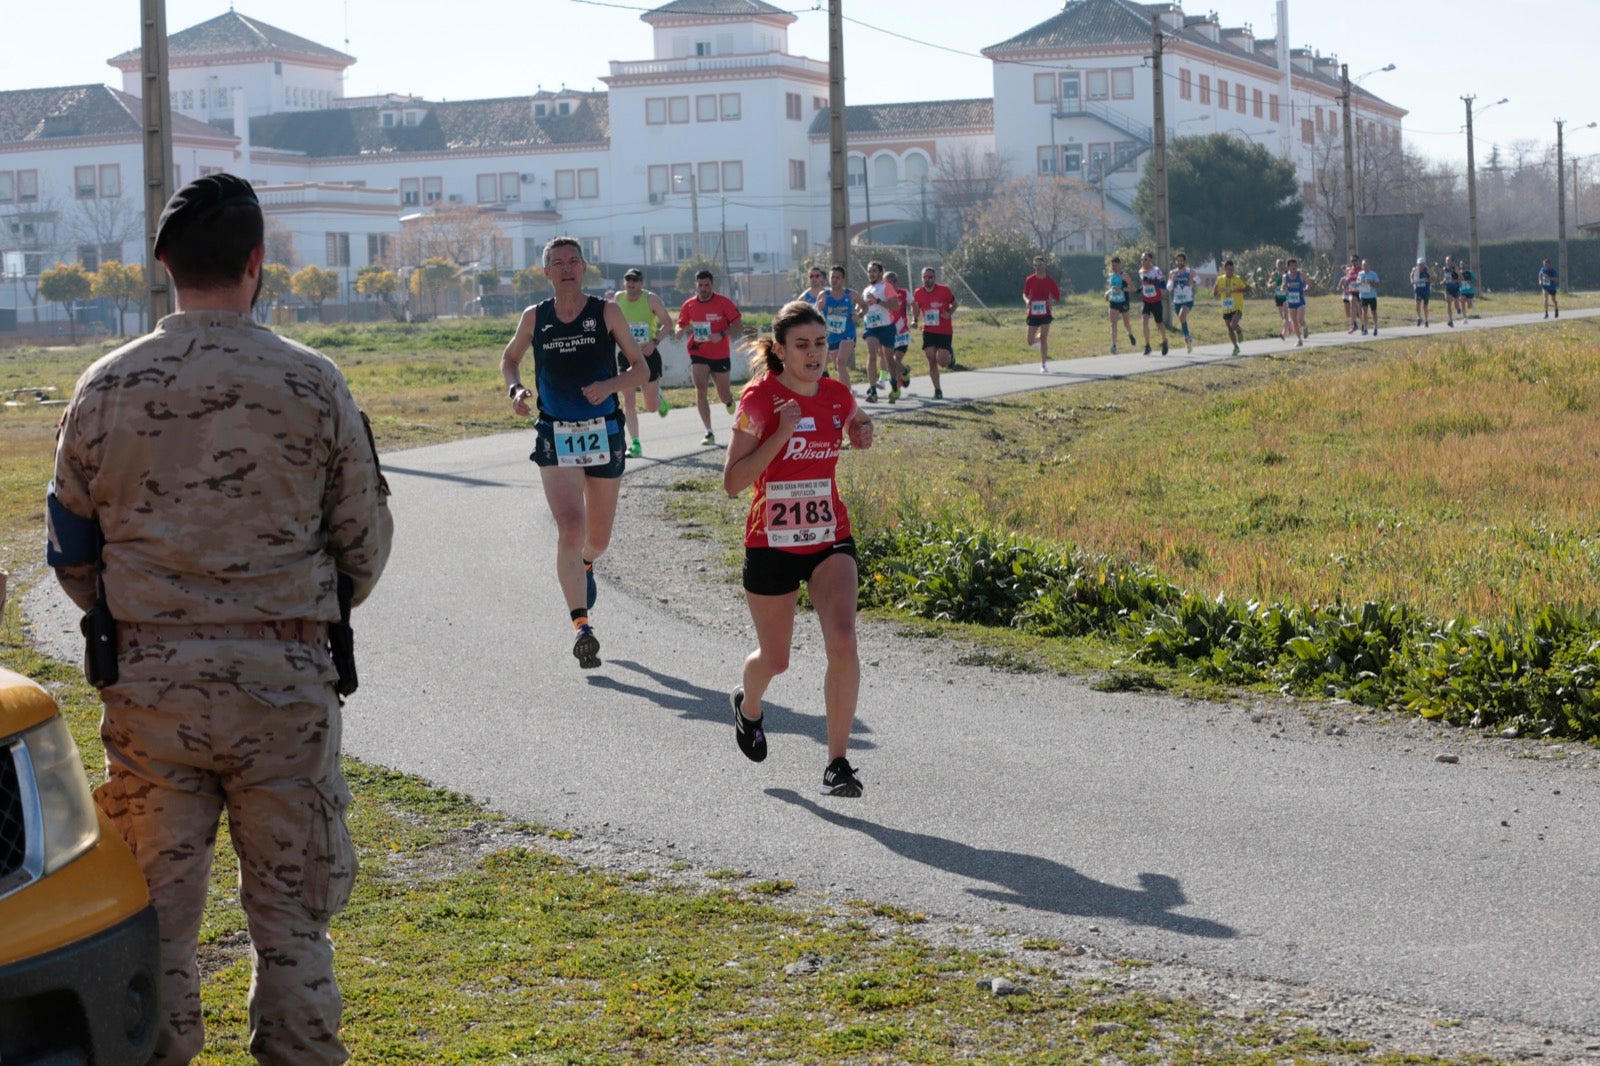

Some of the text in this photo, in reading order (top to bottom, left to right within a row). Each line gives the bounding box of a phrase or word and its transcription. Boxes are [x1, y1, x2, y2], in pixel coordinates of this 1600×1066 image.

[634, 328, 645, 336] 22
[542, 342, 564, 351] PAZITO
[571, 337, 596, 346] PAZITO
[565, 433, 600, 453] 112
[771, 500, 832, 526] 2183
